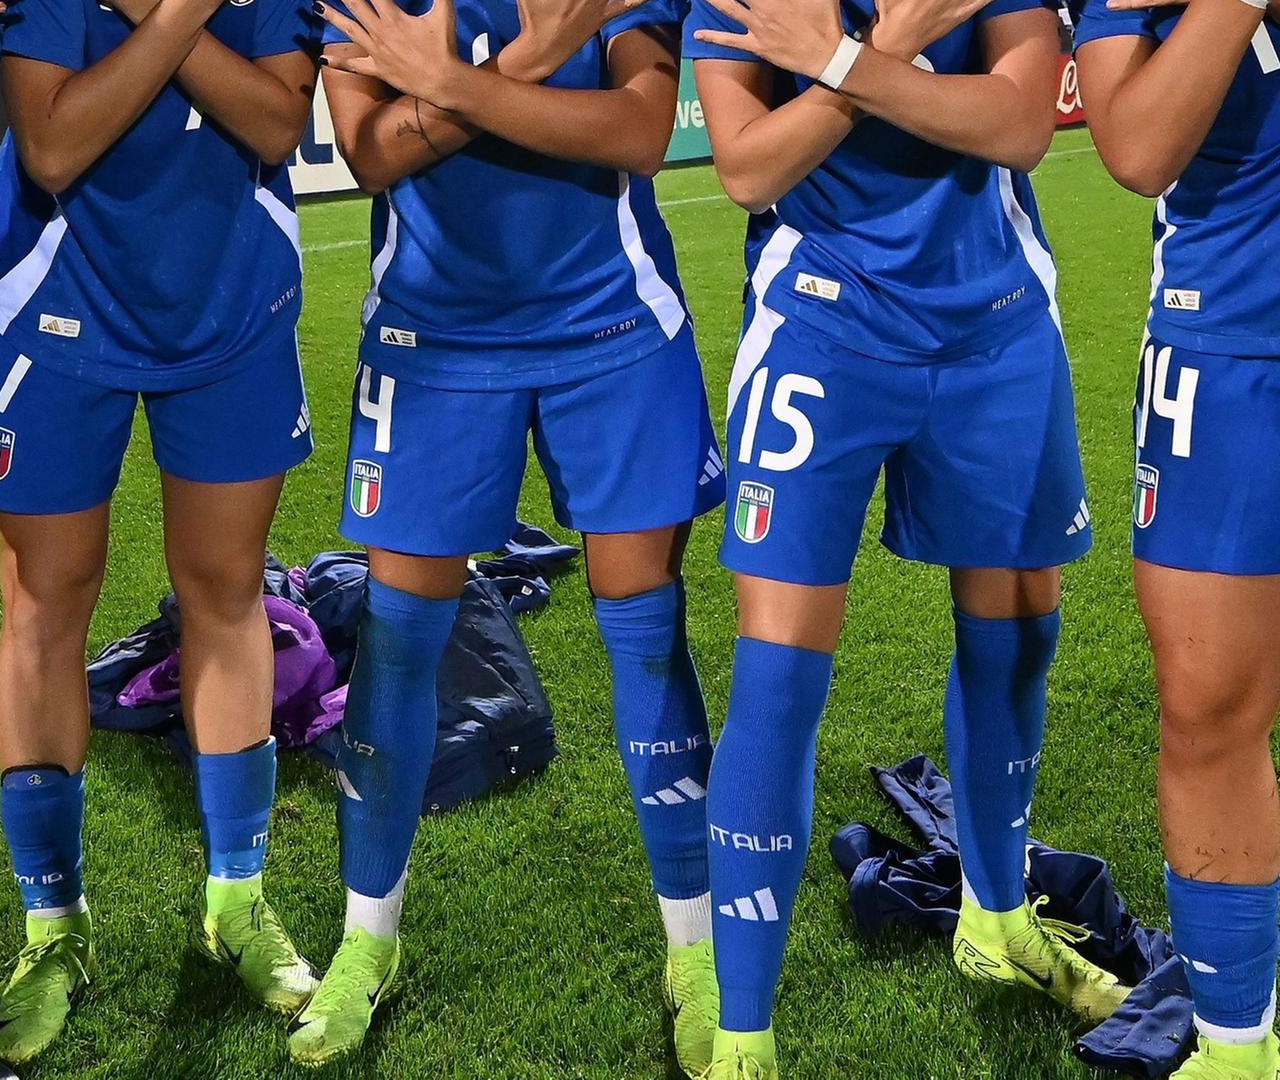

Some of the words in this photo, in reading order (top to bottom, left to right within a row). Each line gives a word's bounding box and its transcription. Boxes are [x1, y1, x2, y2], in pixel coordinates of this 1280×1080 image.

[991, 285, 1026, 312] HEAT.RDY
[359, 364, 396, 454] 4
[1137, 344, 1200, 458] 14
[737, 366, 825, 472] 15
[354, 463, 379, 480] ITALIA
[740, 484, 770, 504] ITALIA
[629, 733, 708, 756] ITALIA
[709, 823, 793, 852] ITALIA
